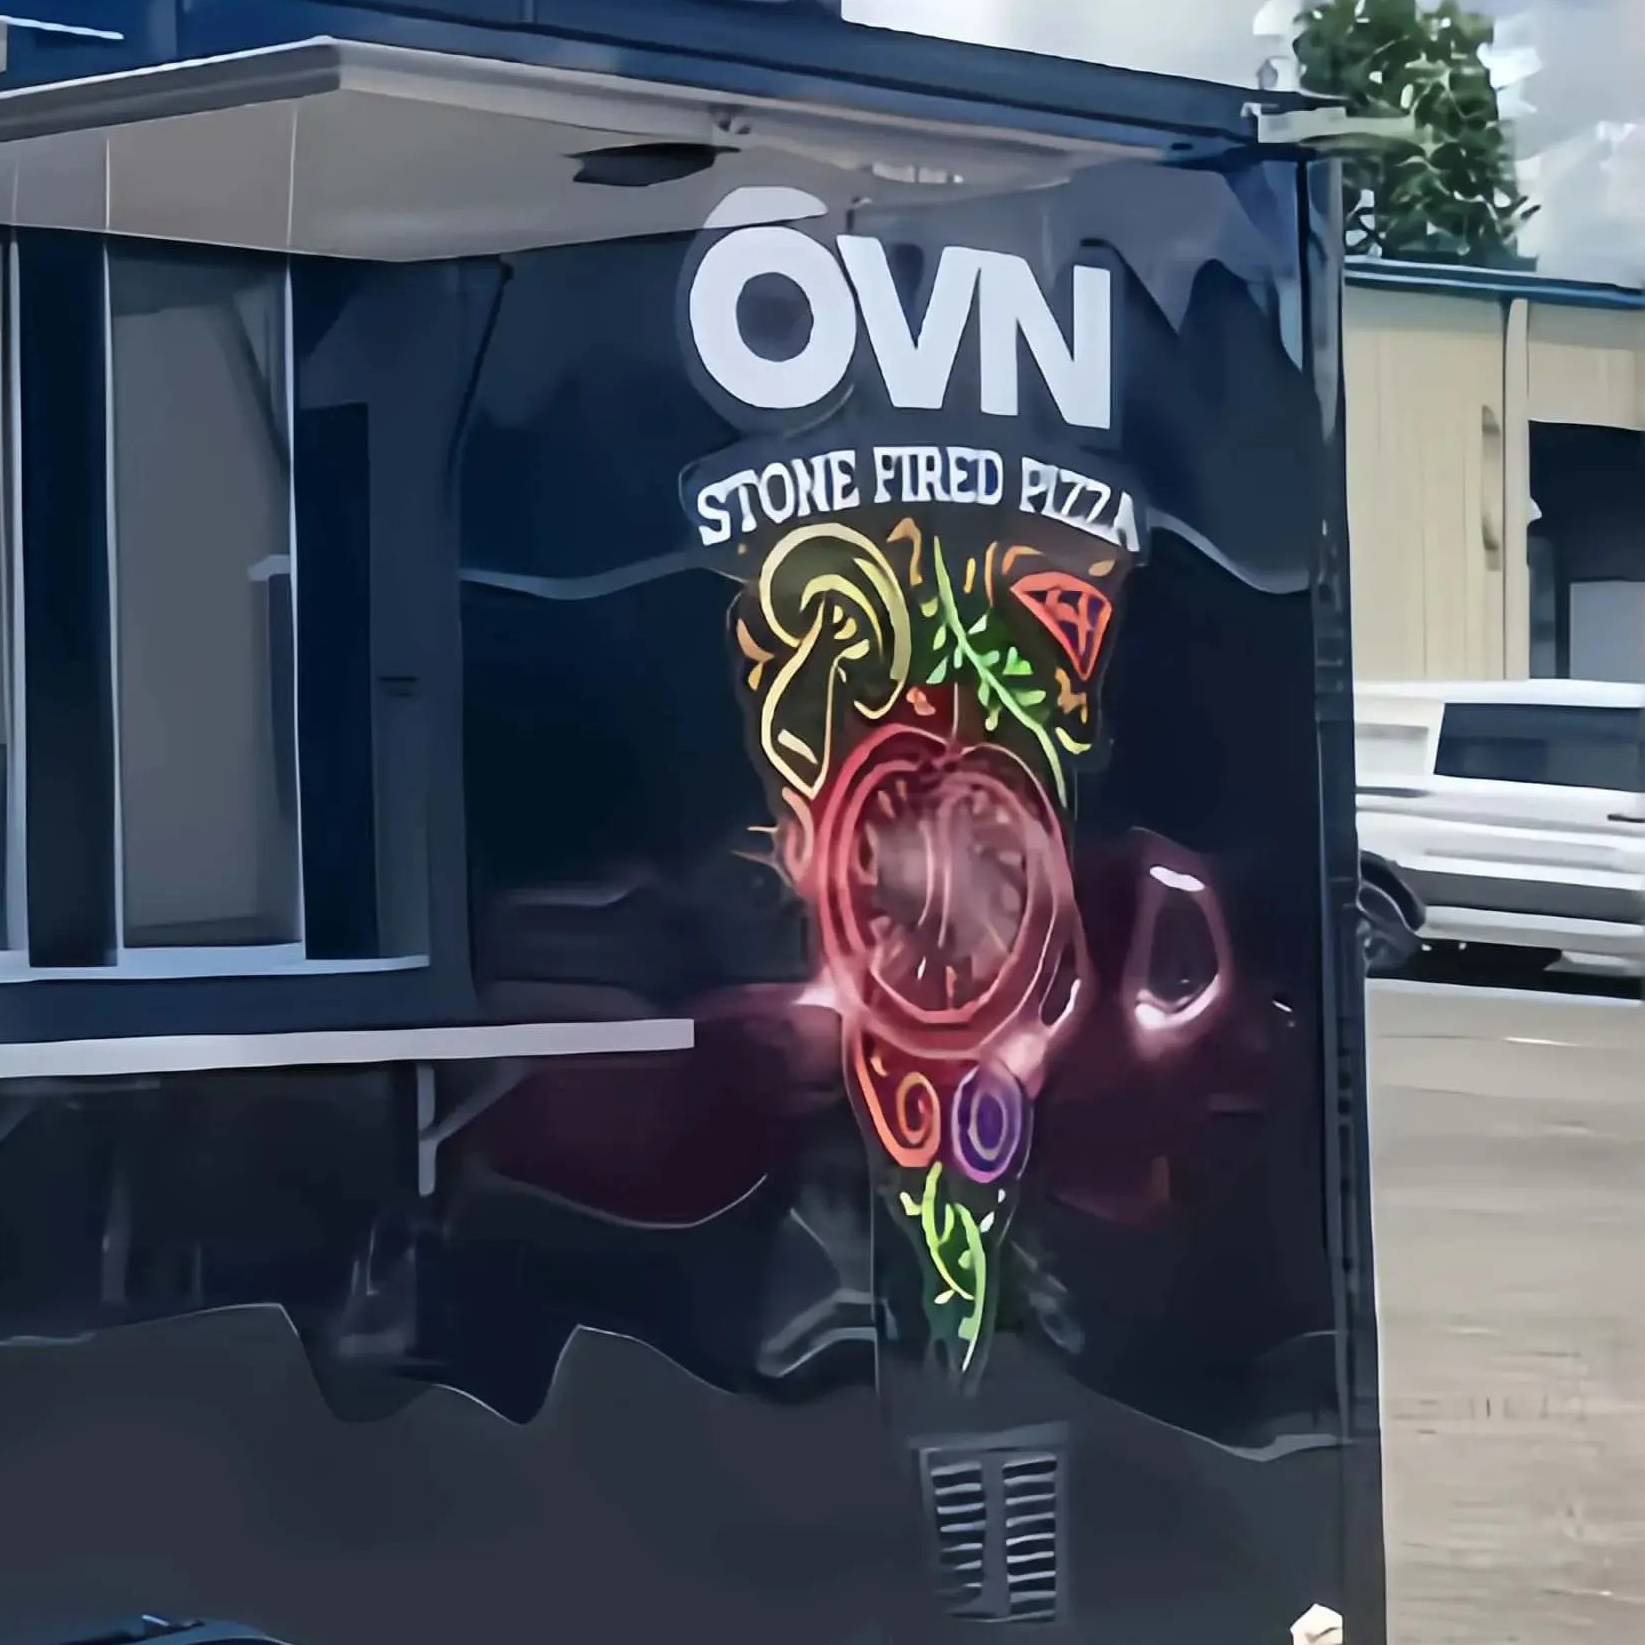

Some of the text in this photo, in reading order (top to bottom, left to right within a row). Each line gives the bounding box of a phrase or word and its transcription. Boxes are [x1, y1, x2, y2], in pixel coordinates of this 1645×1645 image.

[696, 445, 1141, 553] STONE FIRED PIZZA
